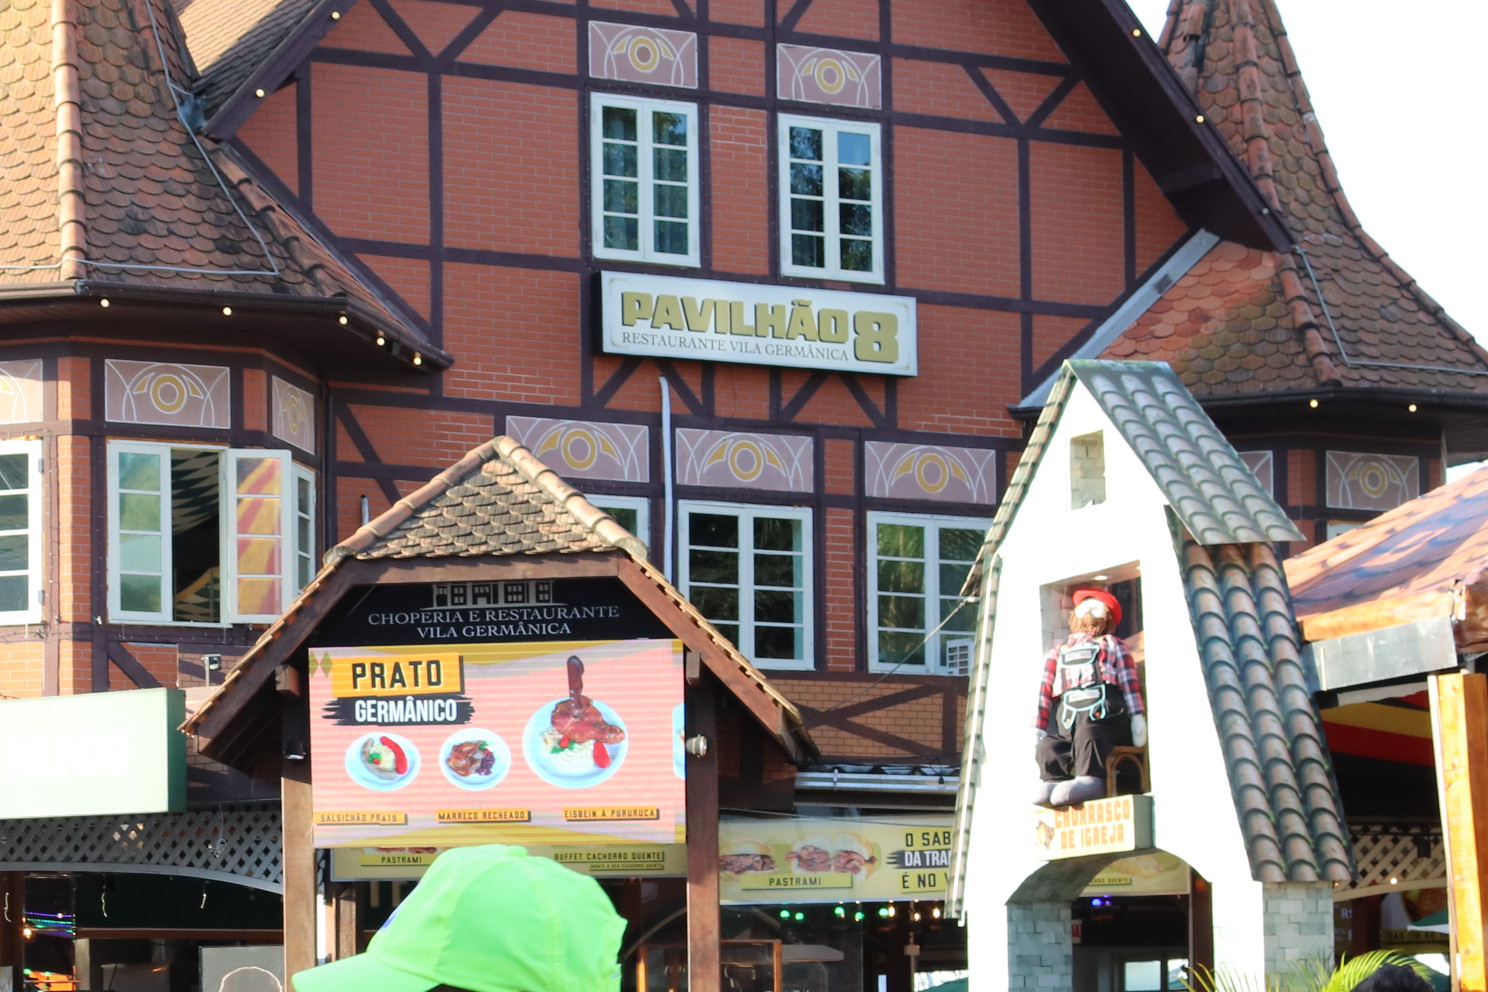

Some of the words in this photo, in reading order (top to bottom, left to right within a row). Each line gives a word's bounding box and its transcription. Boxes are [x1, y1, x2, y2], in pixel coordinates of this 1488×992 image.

[621, 291, 850, 344] PAVILHÃO
[853, 310, 900, 364] 8
[622, 331, 727, 352] RESTAURANTE
[729, 340, 762, 355] VILA
[764, 343, 850, 361] GERMÂNICA
[368, 611, 464, 626] CHOPERIA
[469, 610, 481, 622] E
[485, 605, 620, 622] RESTAURANTE
[417, 625, 458, 639] VILA
[461, 621, 572, 637] GERMÂNICA
[352, 660, 443, 690] PRATO
[354, 696, 458, 723] GERMÂNICO
[320, 813, 367, 823] SALSICHÃO
[370, 813, 397, 823] PRATO
[438, 811, 477, 821] MARRECO
[479, 811, 526, 820] RECHEADO
[564, 810, 598, 819] EISBEIN
[610, 808, 656, 818] PURURUCA
[1055, 799, 1131, 828] CHURRASCO
[905, 832, 914, 847] O
[922, 832, 952, 847] SAB
[1061, 830, 1075, 849] DE
[1080, 823, 1125, 847] IGREJA
[381, 856, 422, 864] PASTRAMI
[554, 853, 584, 862] BUFFET
[586, 852, 628, 861] CACHORRO
[632, 851, 661, 860] QUENTE
[904, 852, 921, 868] DA
[769, 877, 822, 887] PASTRAMI
[902, 872, 910, 889] É
[917, 873, 937, 888] NO
